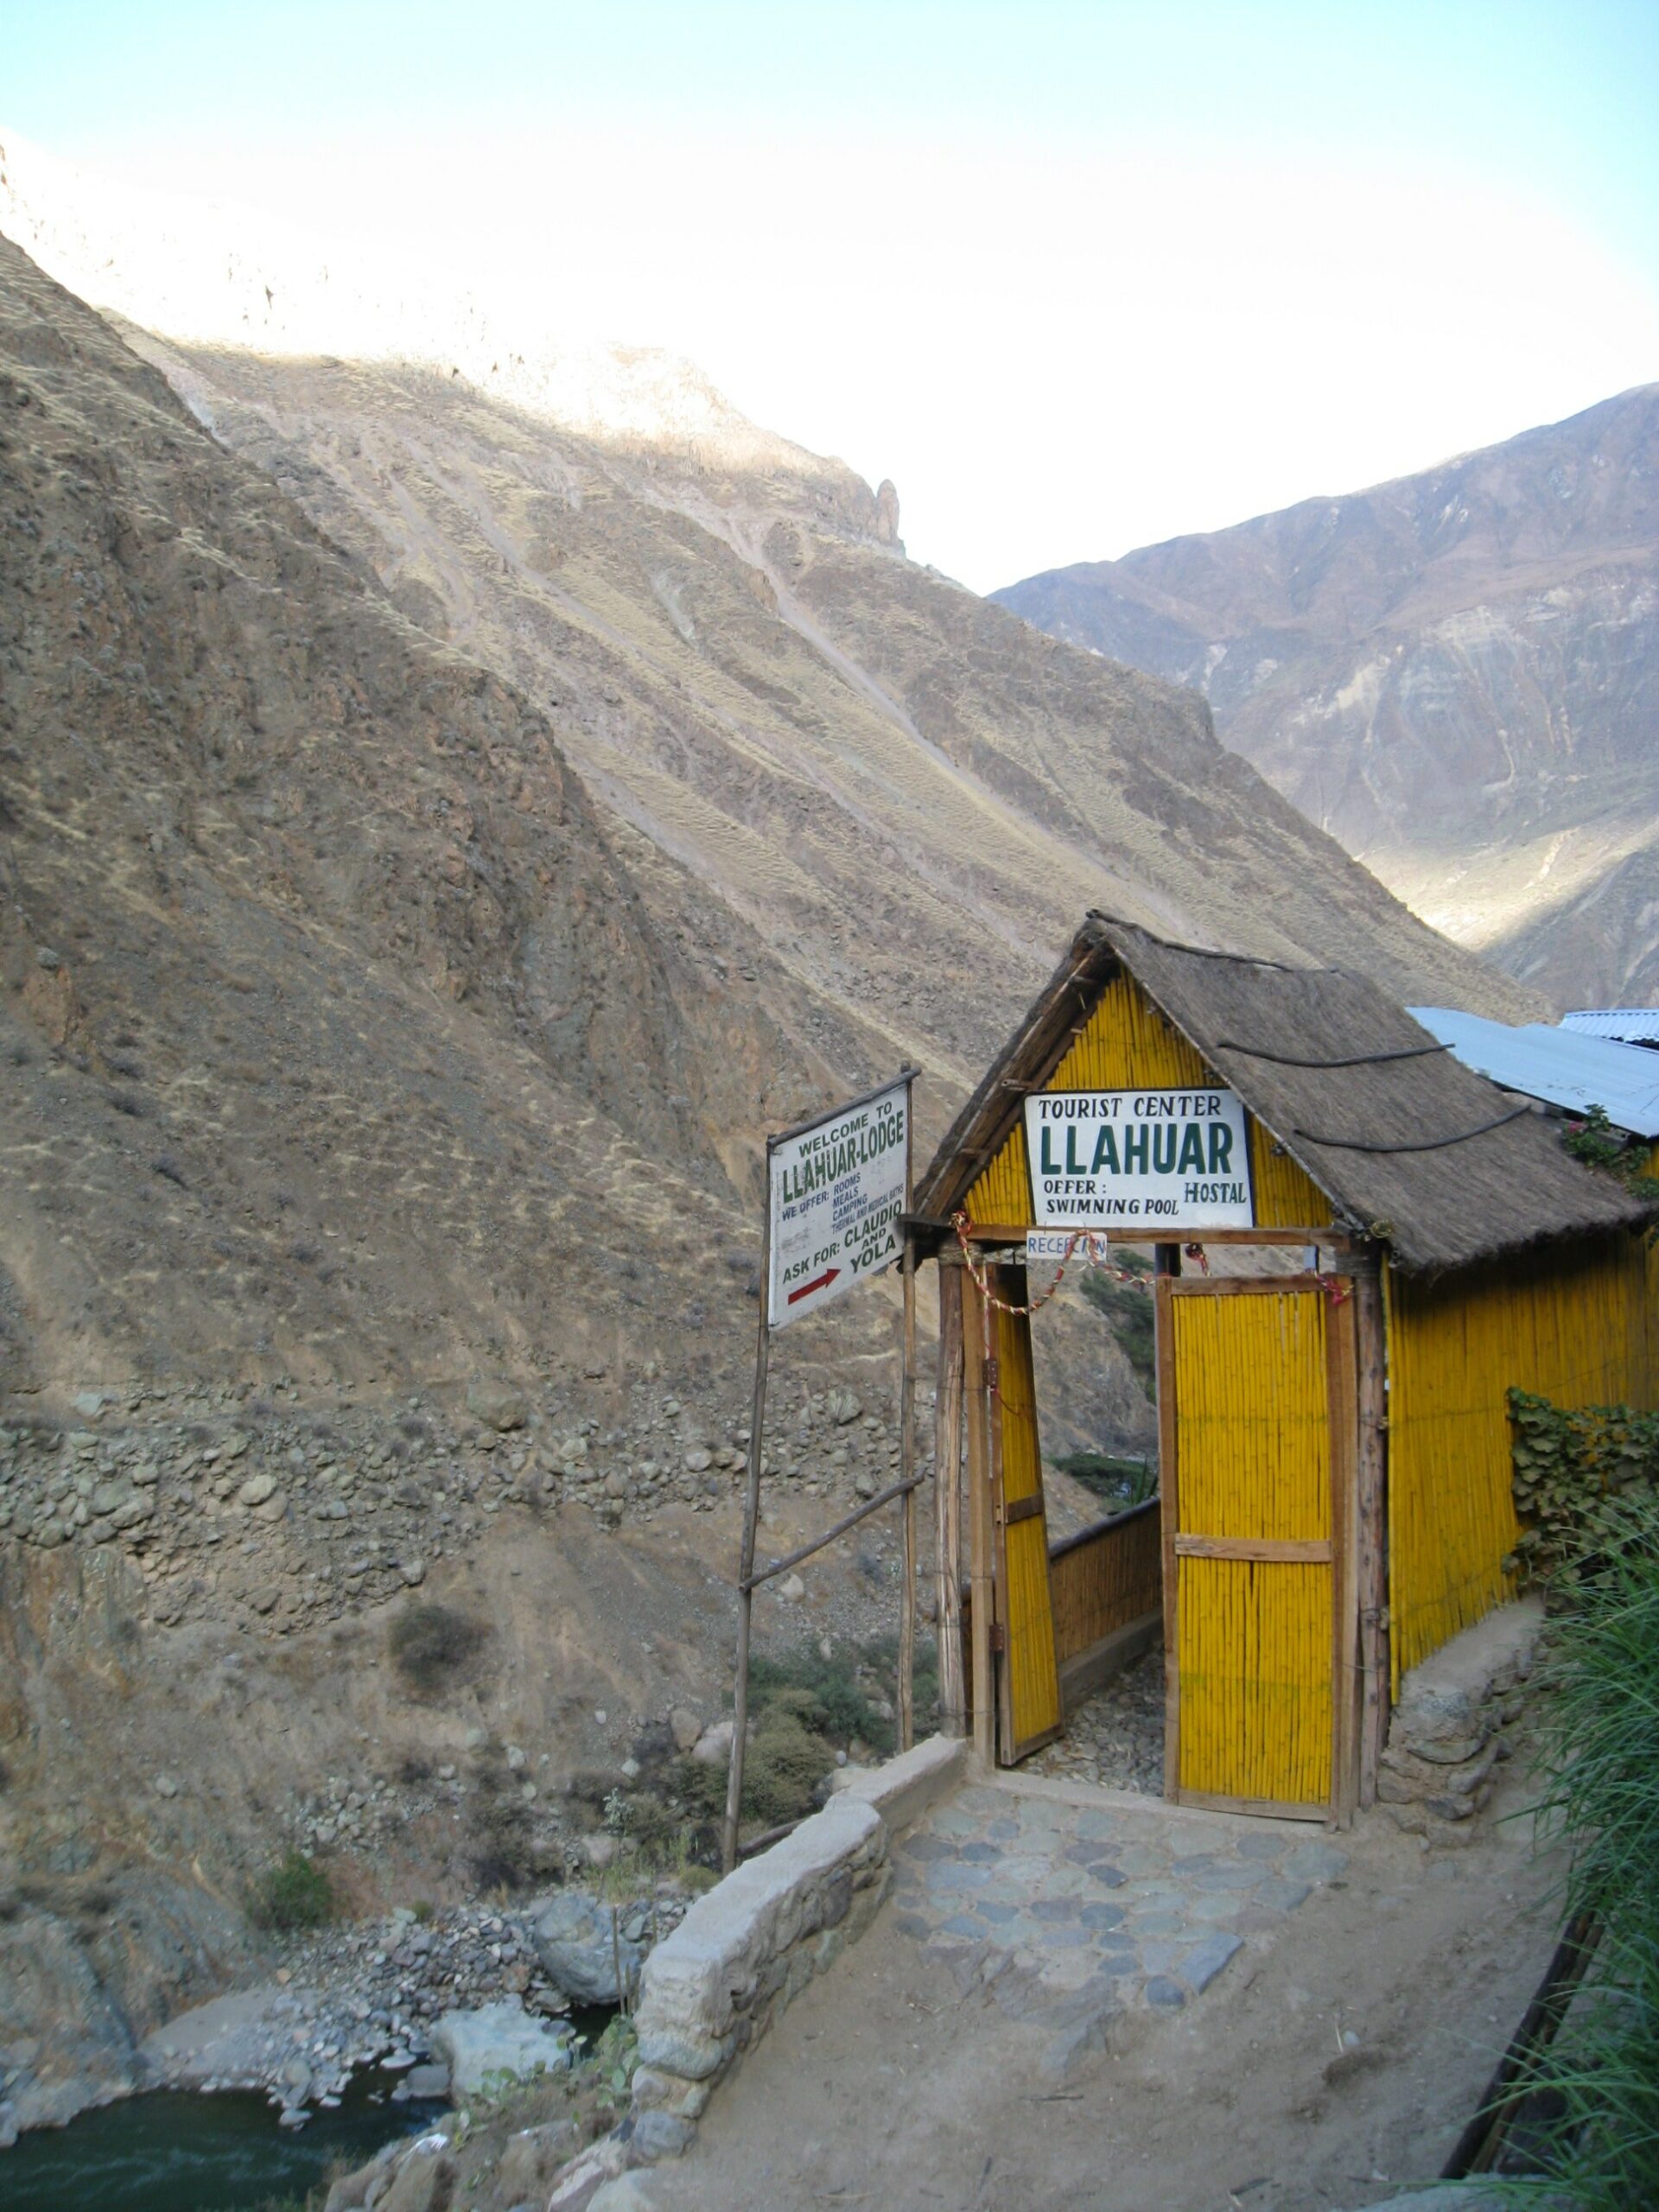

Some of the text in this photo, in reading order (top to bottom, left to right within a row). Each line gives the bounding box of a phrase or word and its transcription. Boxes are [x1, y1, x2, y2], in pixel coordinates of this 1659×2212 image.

[1039, 1096, 1222, 1118] TOURIST CENTER
[798, 1101, 893, 1158] WELCOME TO
[783, 1110, 904, 1204] LLAHUAR-LODGE
[1041, 1122, 1233, 1175] LLAHUAR
[782, 1172, 861, 1222] WE OFFER: ROOMS
[832, 1193, 868, 1221] CAMPING
[833, 1186, 859, 1210] MEALS
[1144, 1199, 1179, 1215] POOL
[1185, 1182, 1246, 1204] HOSTAL
[783, 1199, 902, 1284] ASK FOR: CLAUDIO
[850, 1234, 896, 1274] YOLA
[861, 1228, 887, 1250] AND
